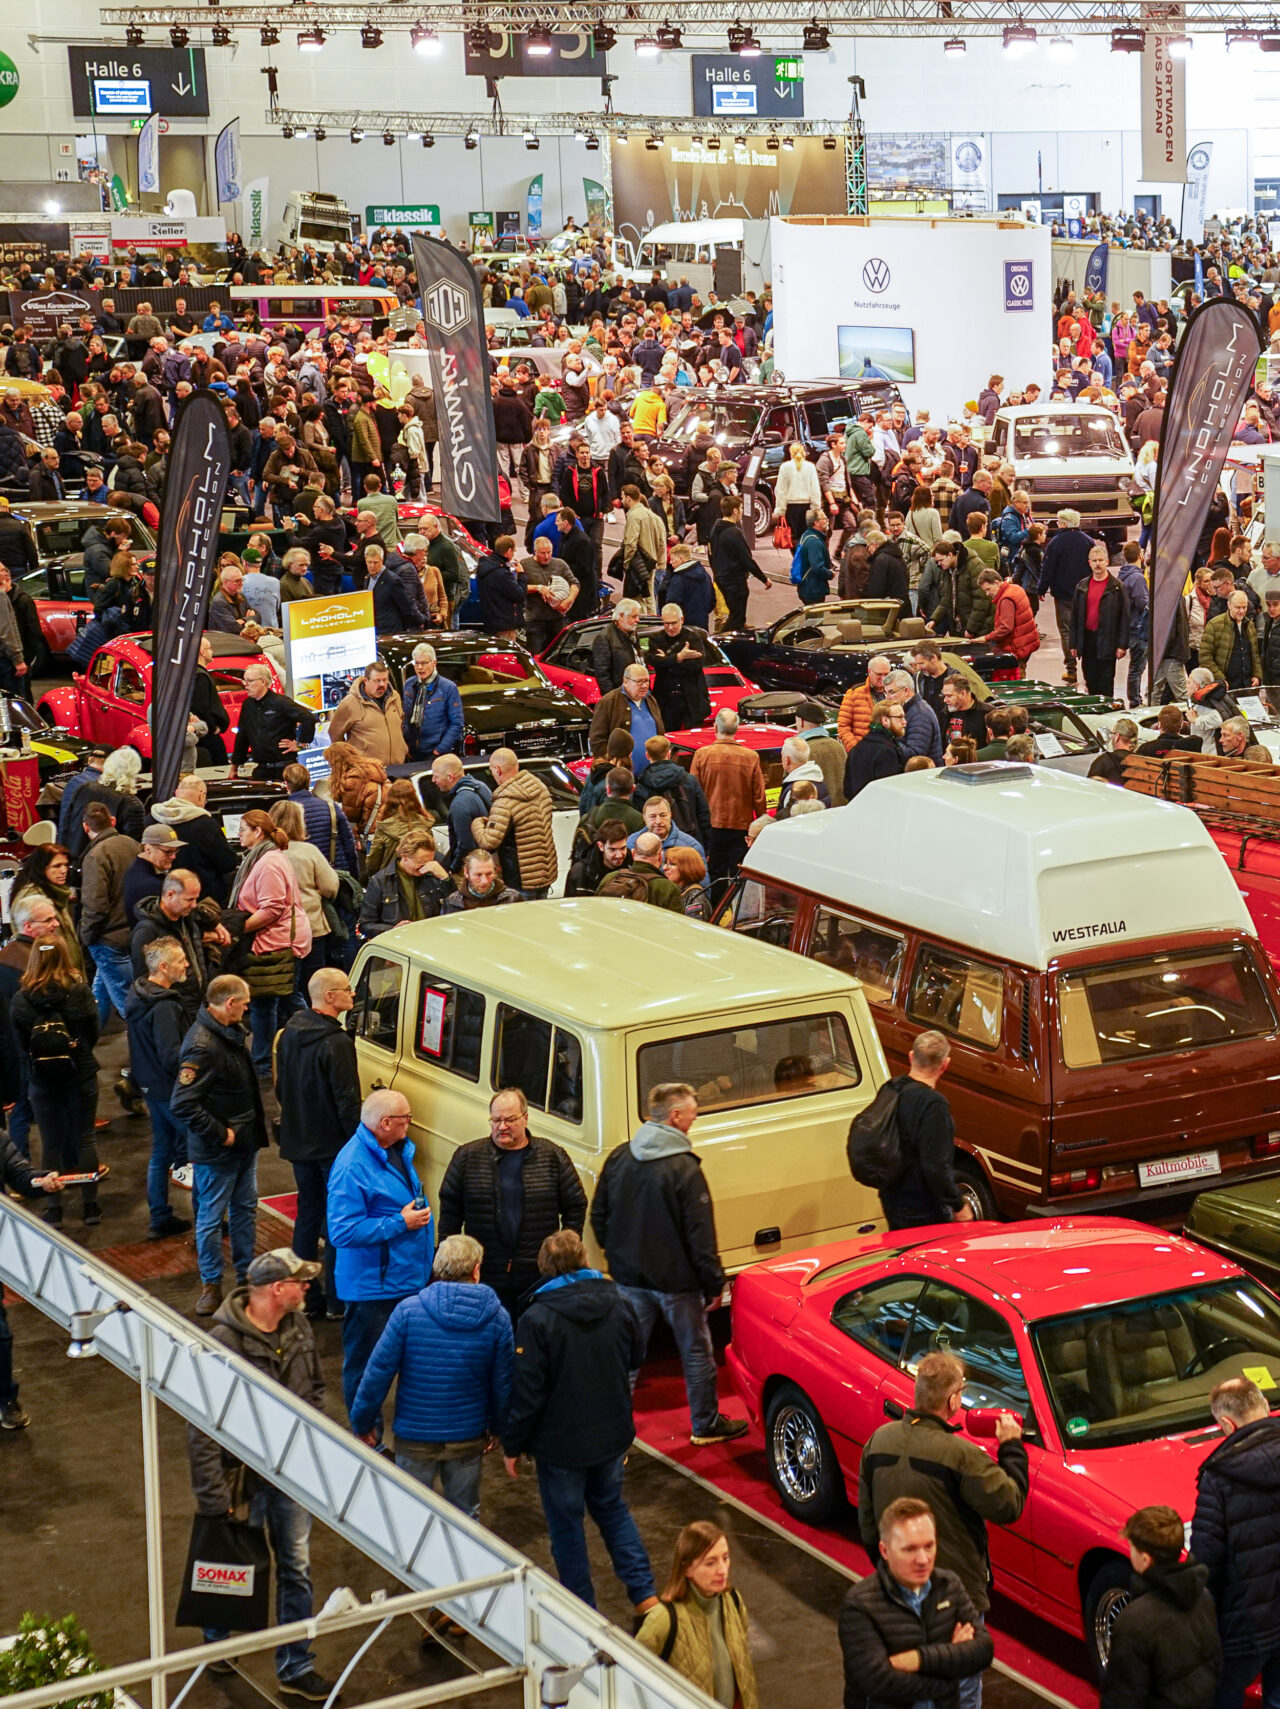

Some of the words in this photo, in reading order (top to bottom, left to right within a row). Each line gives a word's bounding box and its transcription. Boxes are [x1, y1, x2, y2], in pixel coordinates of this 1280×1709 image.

[85, 61, 129, 78] Halle
[132, 64, 142, 77] 6
[706, 68, 740, 83] Halle
[742, 70, 750, 82] 6
[1165, 36, 1174, 162] ORTWAGEN
[251, 190, 262, 239] klassik
[383, 208, 432, 223] klassik
[854, 300, 900, 311] Nutzfahrzeuge
[1178, 322, 1244, 506] LINDHOLM
[1201, 354, 1246, 484] COLLECTION
[170, 422, 216, 665] LINDHOLM
[300, 609, 364, 625] LINDHOLM
[310, 618, 356, 630] COLLECTION
[513, 736, 558, 745] LINDHOLM
[1052, 920, 1127, 943] WESTFALIA
[1146, 1154, 1208, 1178] Kultmobile
[196, 1567, 247, 1583] SONAX
